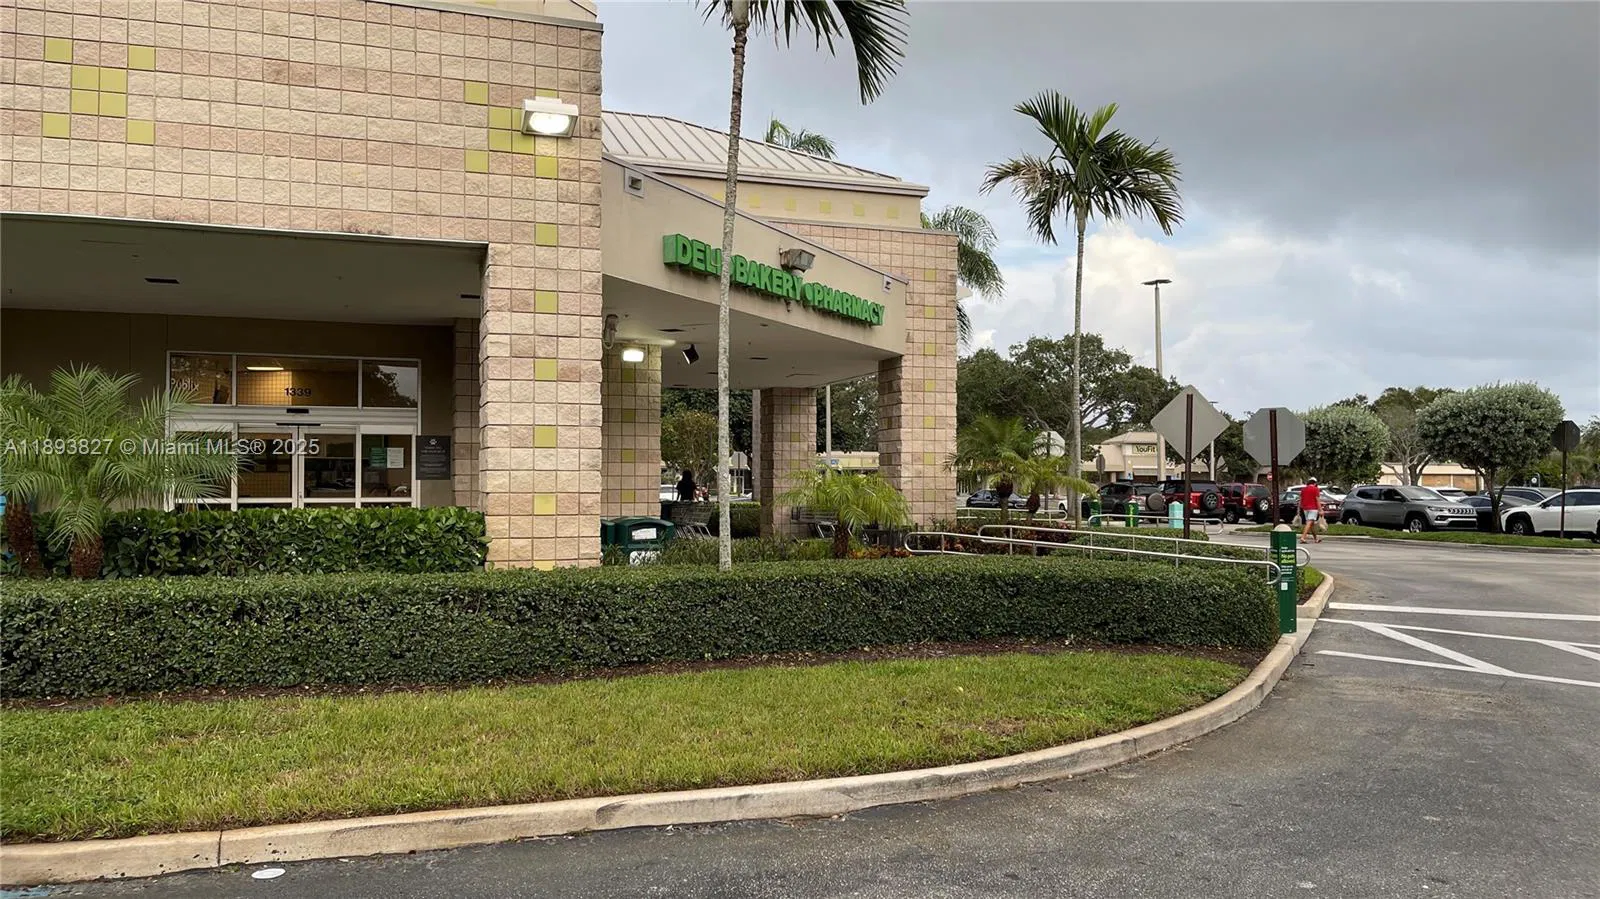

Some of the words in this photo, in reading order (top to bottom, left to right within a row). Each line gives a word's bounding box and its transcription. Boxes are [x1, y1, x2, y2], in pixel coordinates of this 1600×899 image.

[664, 233, 722, 276] DELI
[732, 254, 803, 301] BAKERY
[813, 282, 885, 326] PHARMACY
[170, 377, 200, 392] Publix
[284, 387, 312, 397] 1339
[1135, 445, 1157, 453] YouFit
